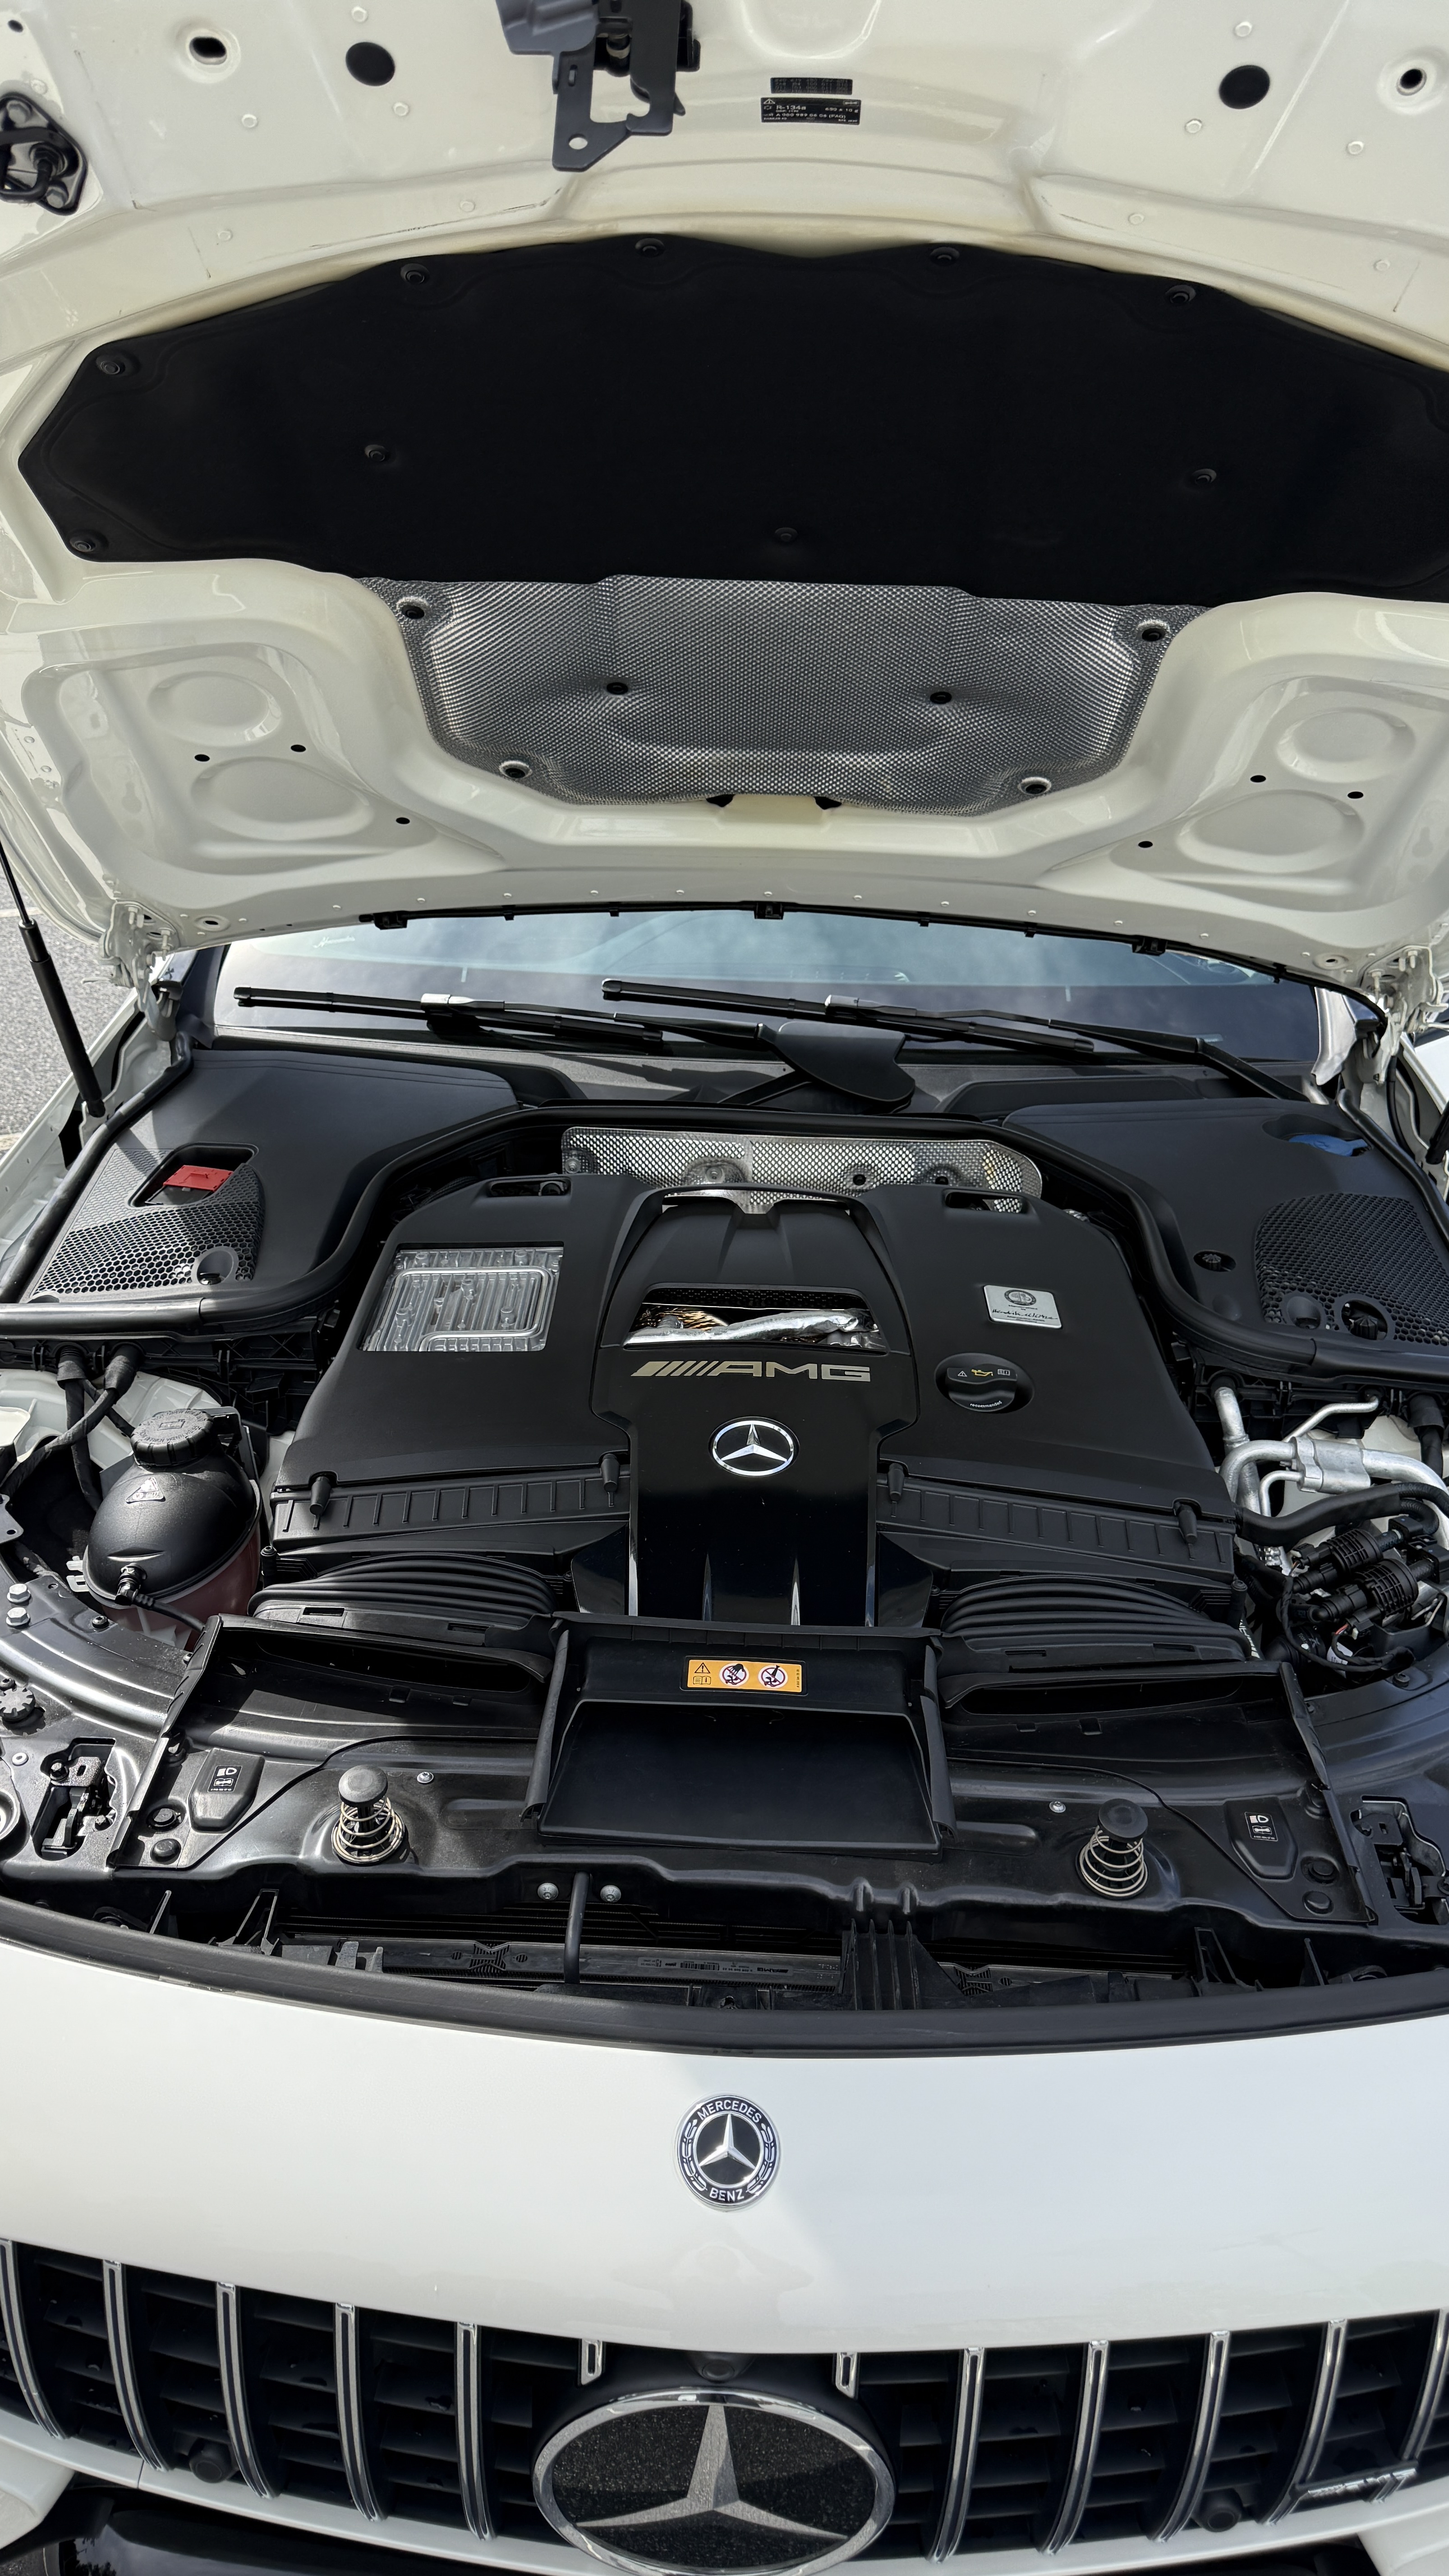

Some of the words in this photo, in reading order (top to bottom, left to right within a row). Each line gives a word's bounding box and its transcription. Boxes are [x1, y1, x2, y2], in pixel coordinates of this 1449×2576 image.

[707, 1361, 870, 1382] AMG
[697, 2100, 762, 2123] MERCEDES
[709, 2187, 745, 2203] BENZ
